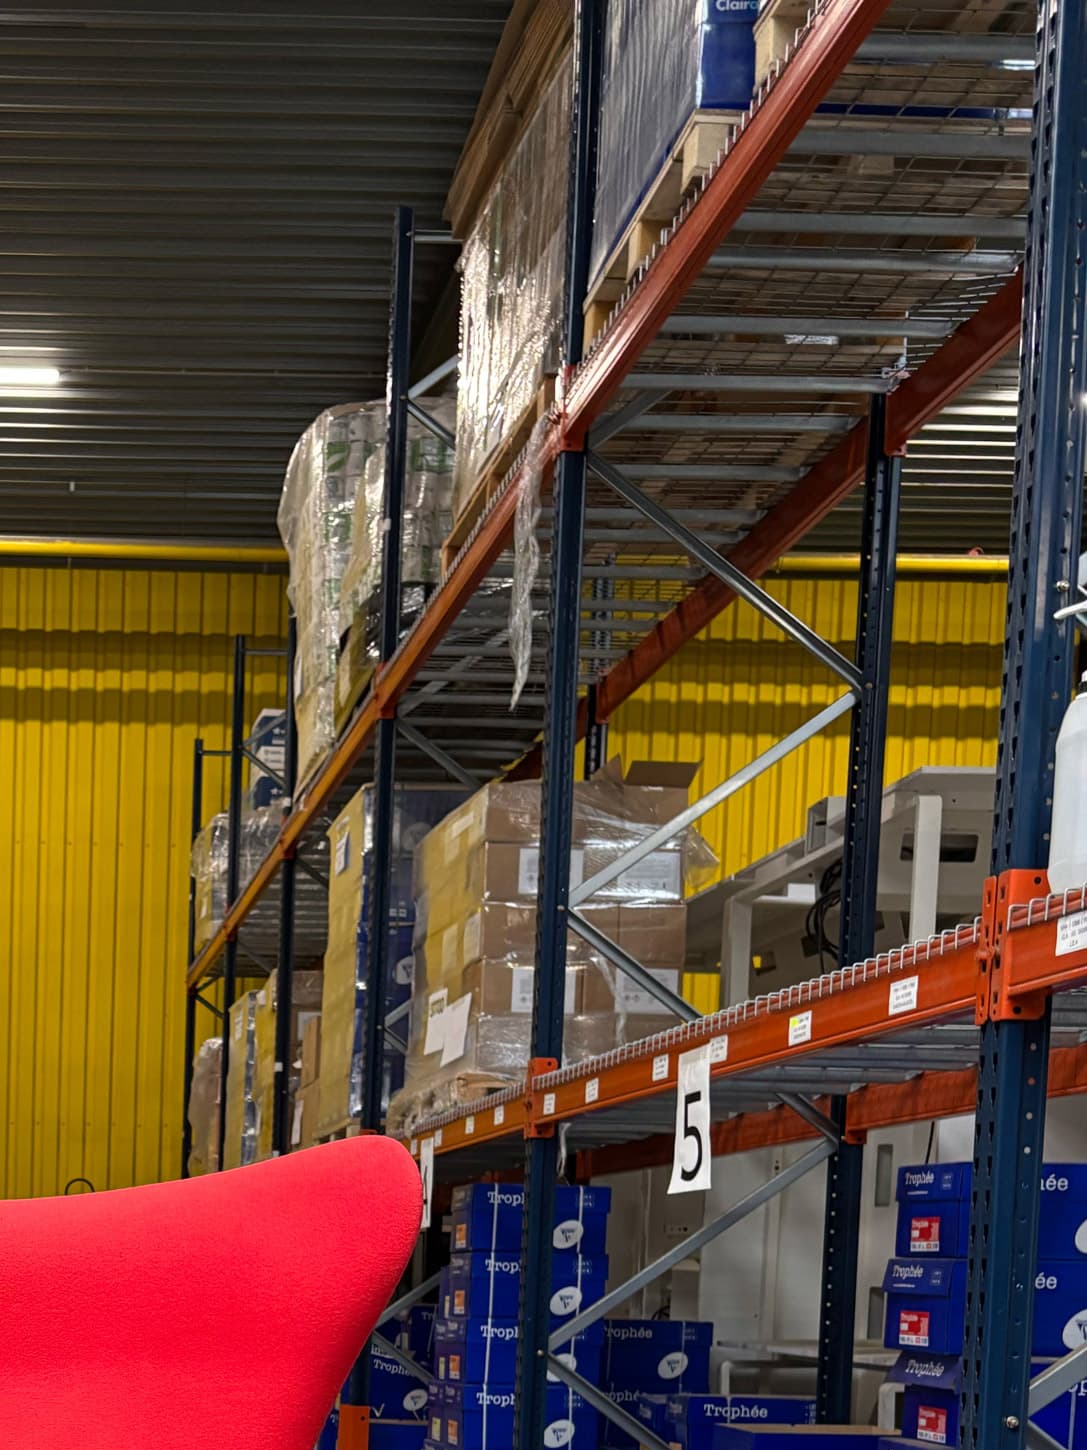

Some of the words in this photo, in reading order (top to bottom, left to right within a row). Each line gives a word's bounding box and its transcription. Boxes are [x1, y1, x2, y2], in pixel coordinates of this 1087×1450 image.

[680, 1090, 703, 1182] 5
[905, 1359, 945, 1377] Trophée
[704, 1403, 768, 1418] Trophée
